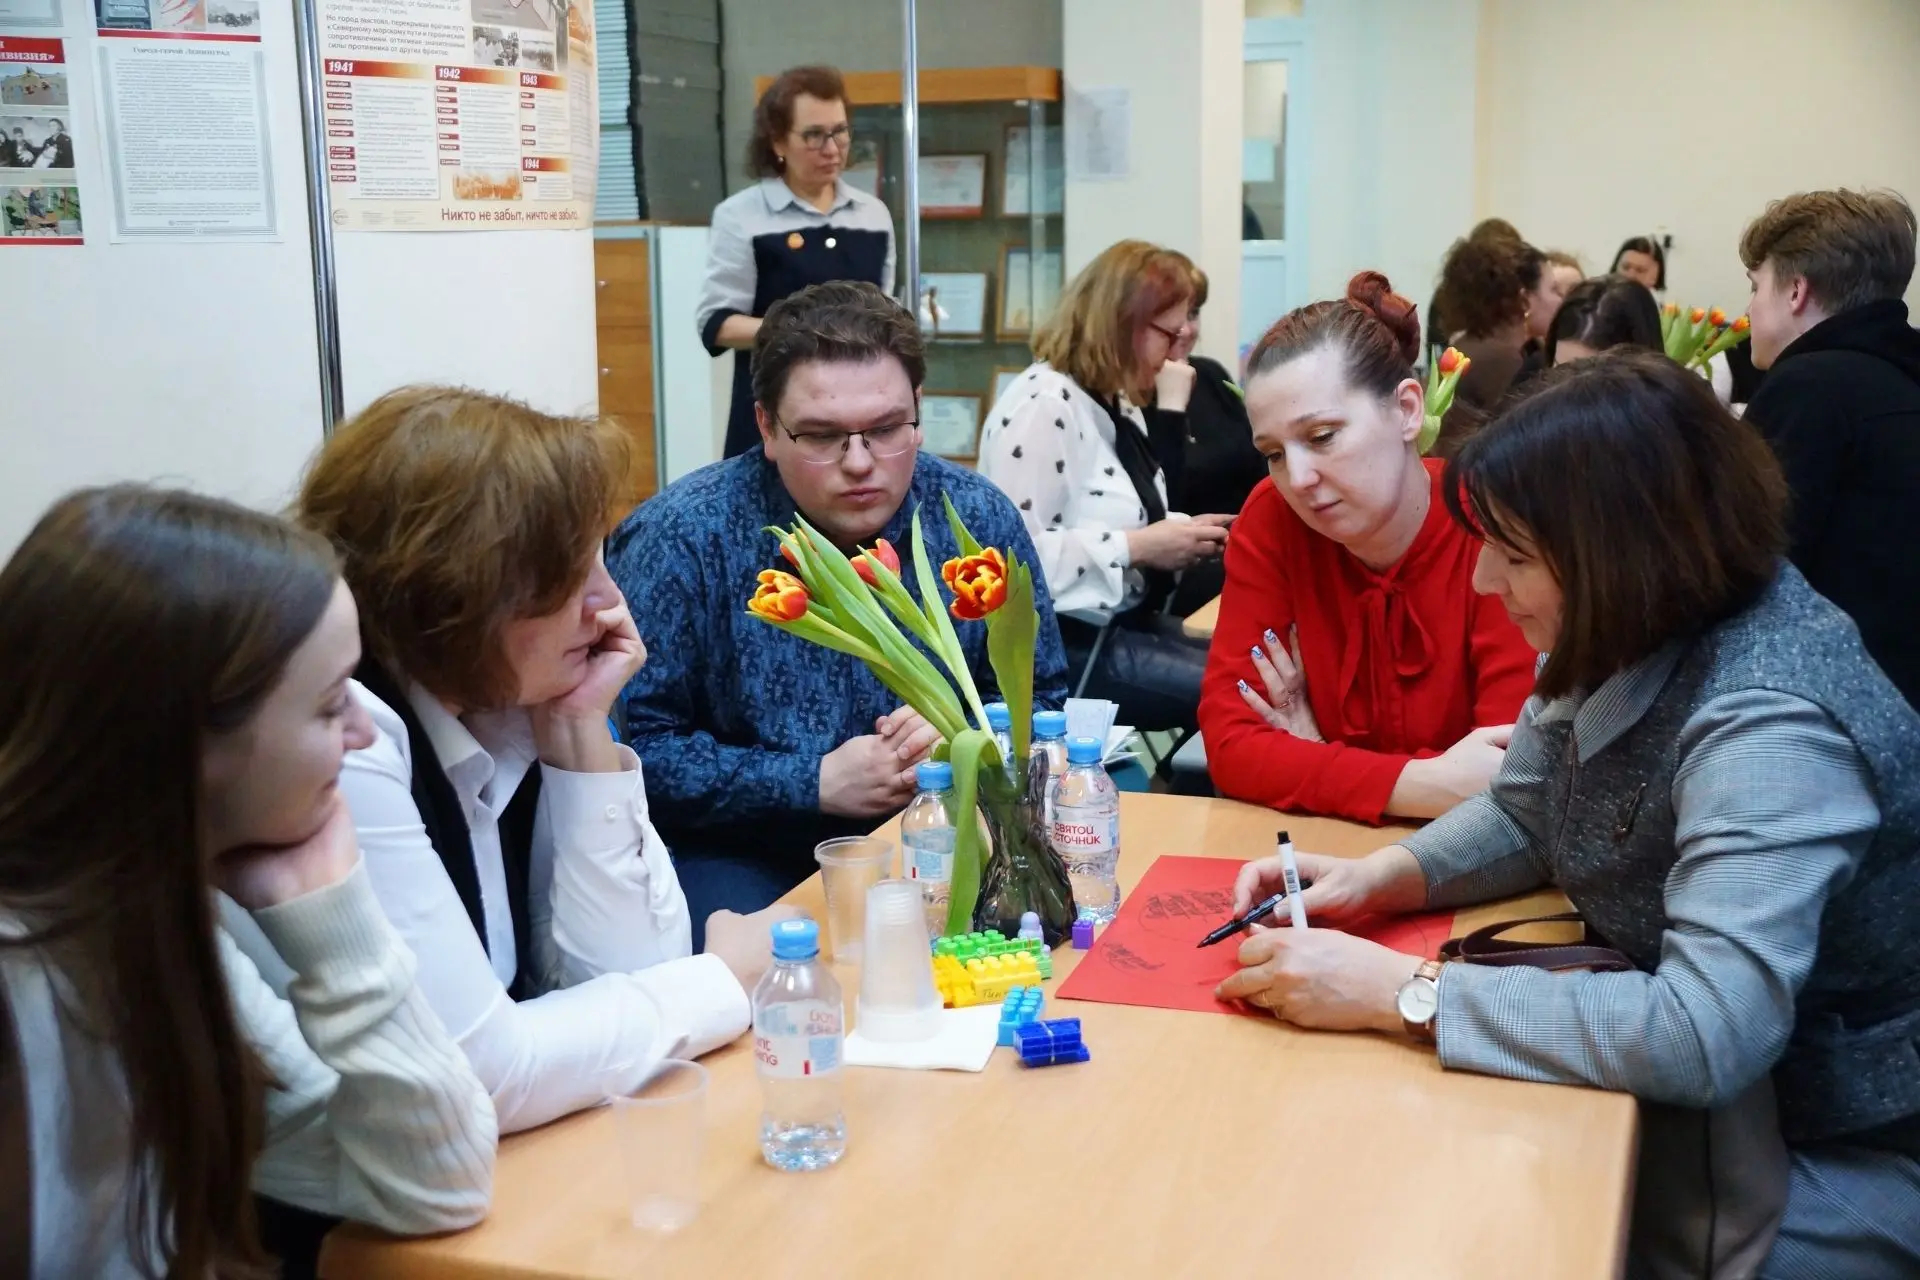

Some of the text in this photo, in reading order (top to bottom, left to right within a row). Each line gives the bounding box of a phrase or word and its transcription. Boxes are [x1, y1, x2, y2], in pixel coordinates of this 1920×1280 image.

[328, 61, 354, 73] 1941
[439, 67, 461, 79] 1942
[522, 74, 538, 86] 1943
[524, 158, 540, 169] 1944
[441, 208, 476, 221] Никто
[479, 212, 491, 221] не
[494, 208, 524, 223] забыт,
[526, 211, 549, 221] ничто
[549, 211, 557, 220] не
[1054, 822, 1094, 835] СВЯТОЙ
[1052, 832, 1101, 845] СТОЧНИК
